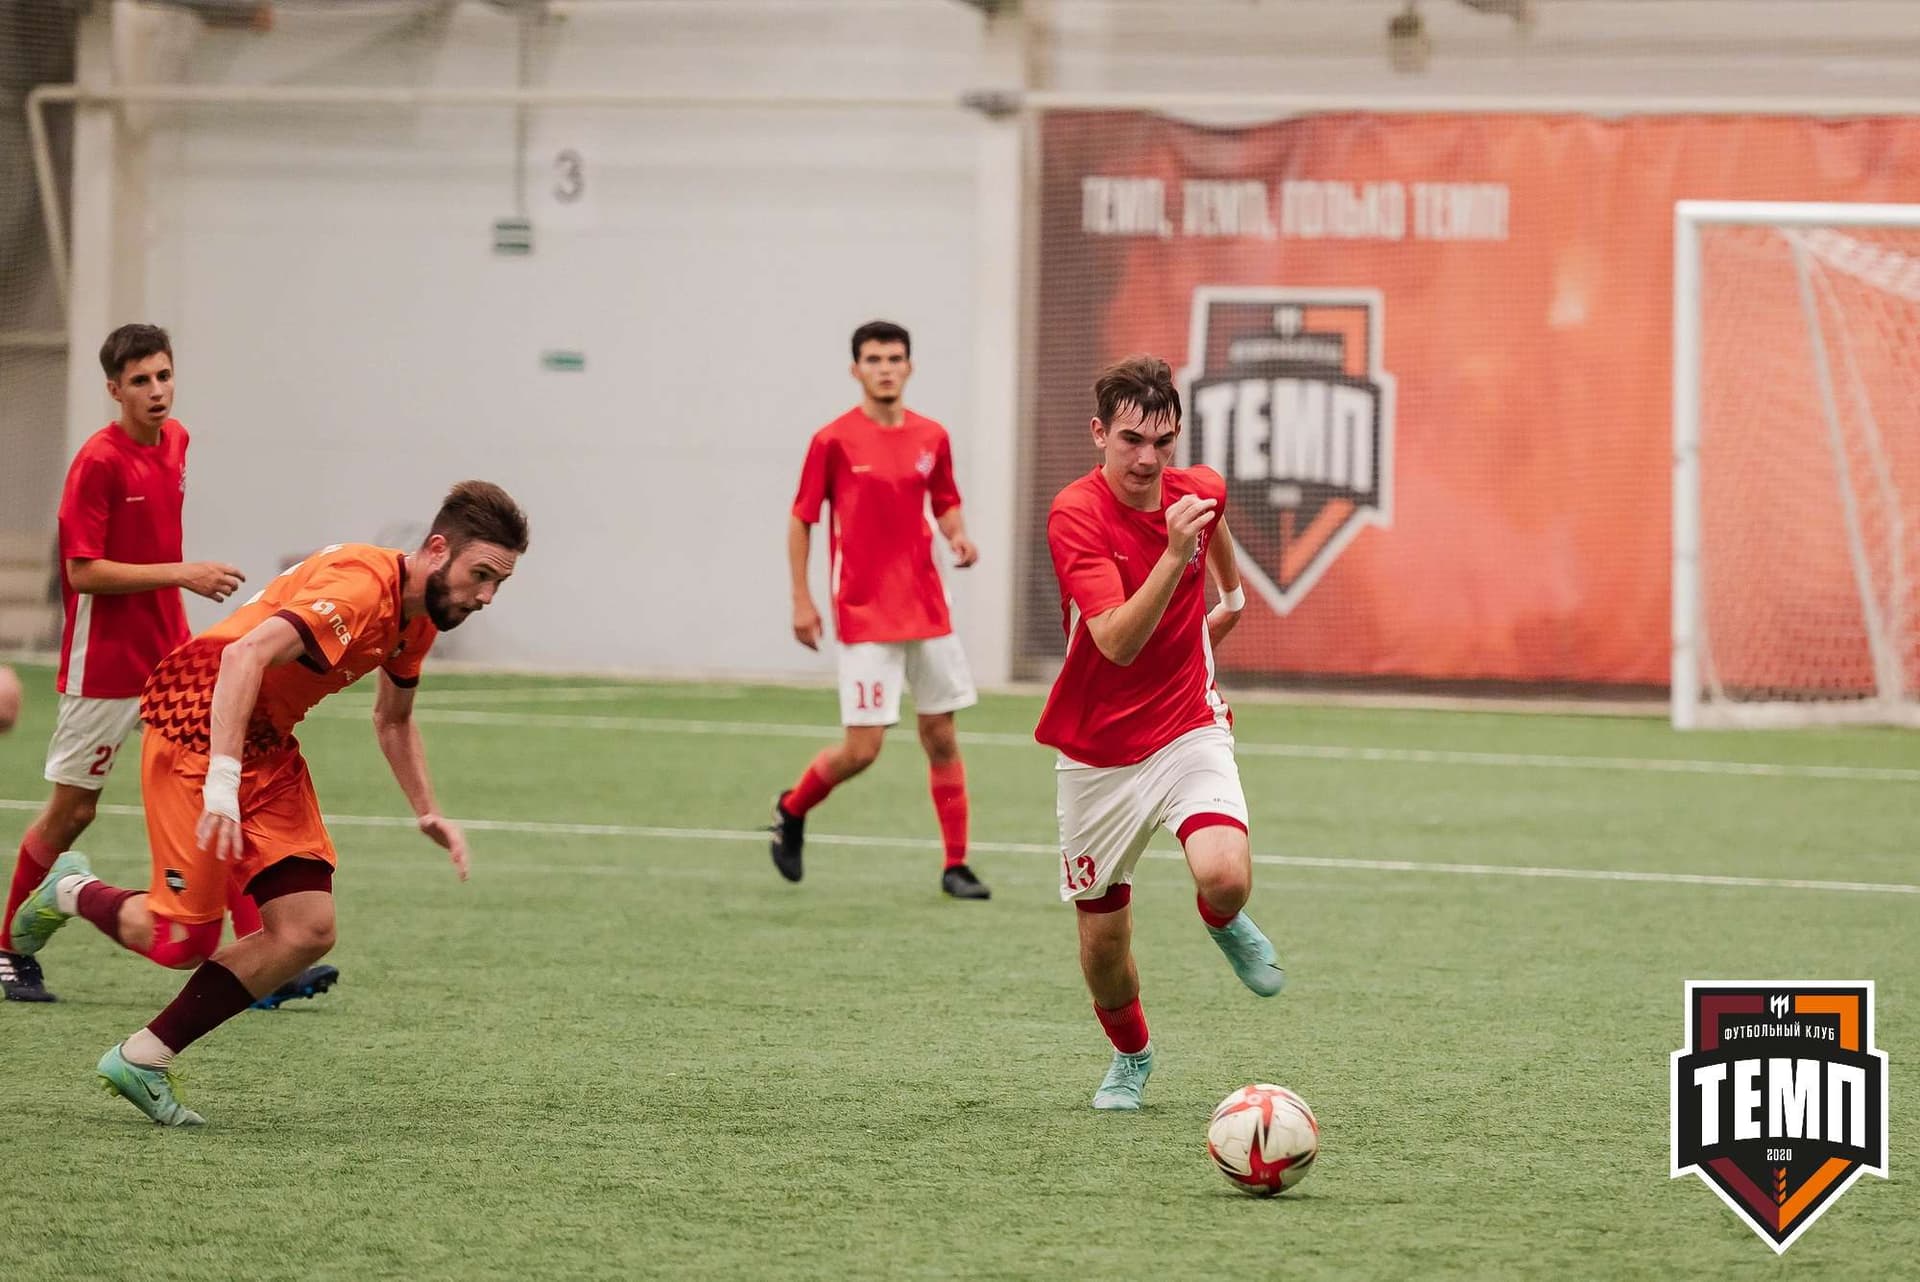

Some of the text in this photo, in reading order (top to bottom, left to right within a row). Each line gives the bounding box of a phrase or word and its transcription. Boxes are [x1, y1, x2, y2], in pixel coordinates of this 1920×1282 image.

[554, 150, 583, 202] 3
[1195, 377, 1375, 493] ТЕМП
[855, 680, 884, 710] 18
[89, 744, 122, 776] 2
[1062, 850, 1096, 890] 13
